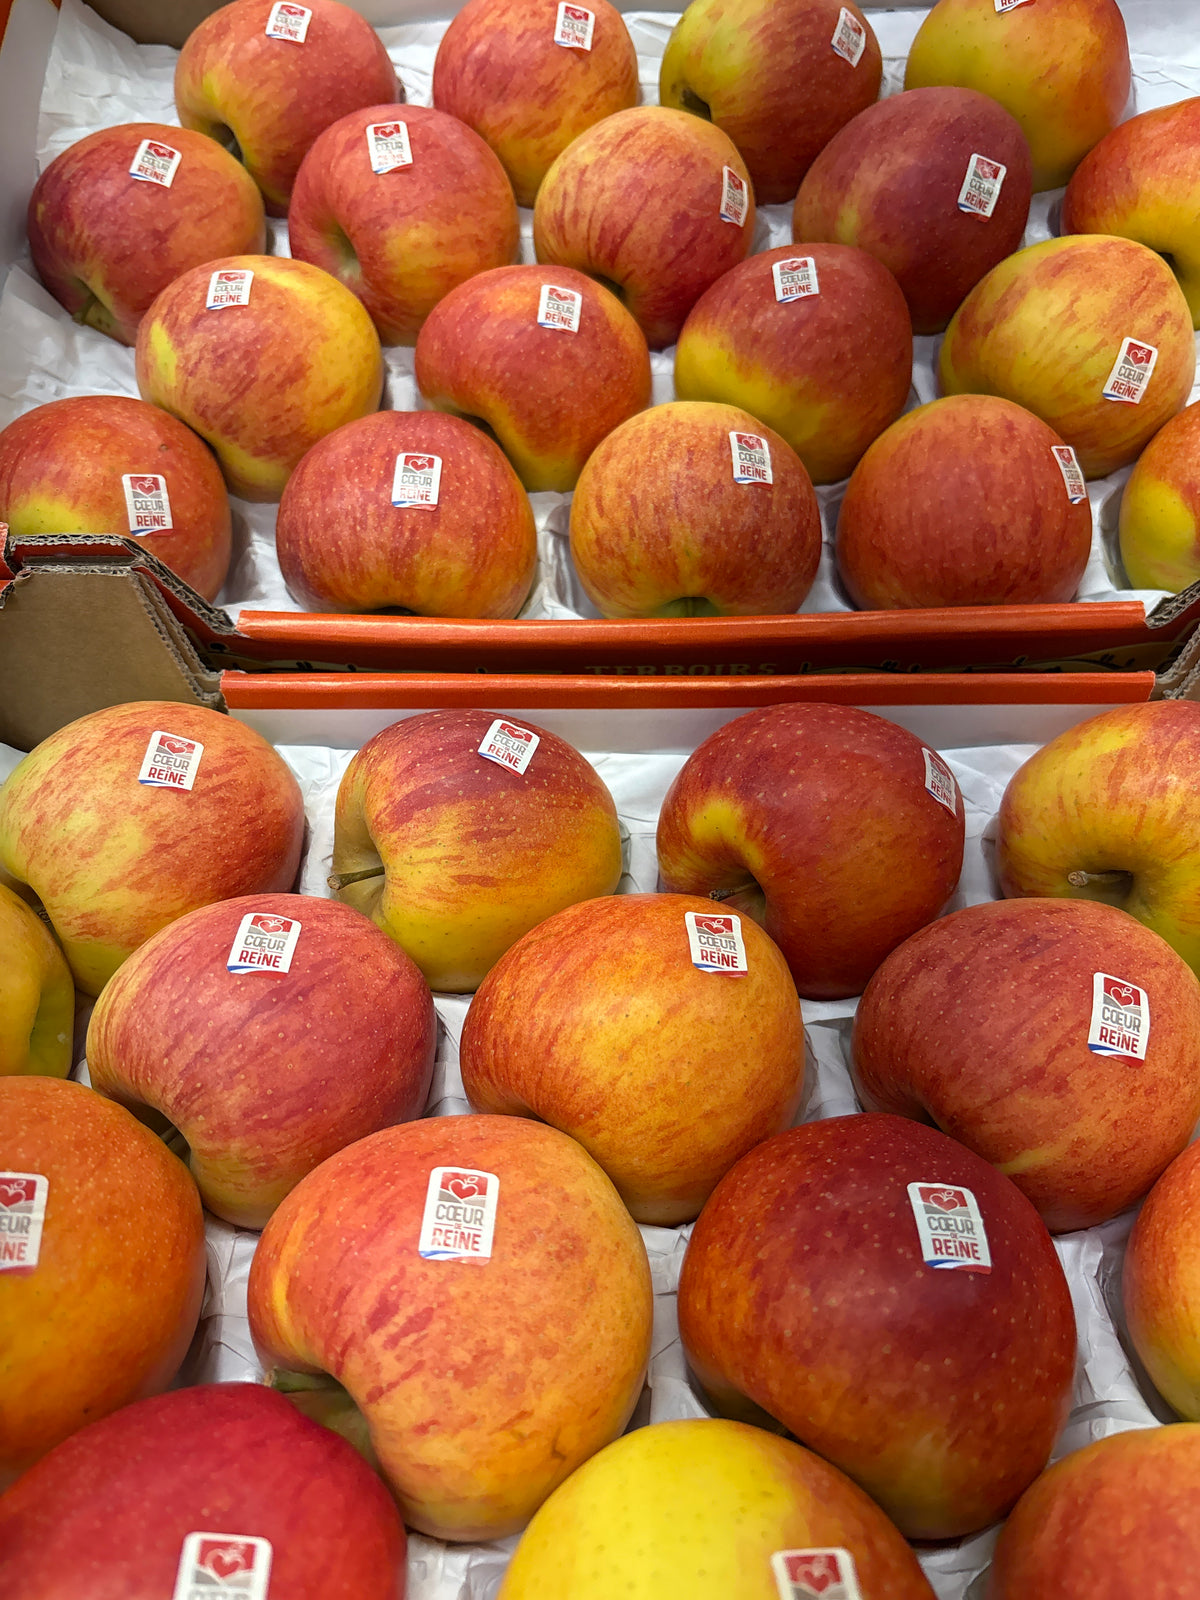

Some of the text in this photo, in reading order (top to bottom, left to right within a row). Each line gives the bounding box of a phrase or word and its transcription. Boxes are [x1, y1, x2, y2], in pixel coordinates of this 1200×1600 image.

[1117, 366, 1144, 385] CŒUR
[739, 451, 766, 467] CŒUR
[401, 474, 432, 487] CŒUR
[134, 500, 164, 511] CŒUR
[493, 733, 527, 756] CŒUR
[153, 753, 190, 771] CŒUR
[488, 743, 521, 769] REiNE
[148, 766, 186, 786] REiNE
[243, 934, 286, 952] CŒUR
[698, 935, 738, 952] CŒUR
[239, 950, 282, 968] REiNE
[701, 949, 740, 969] REiNE
[1101, 1006, 1142, 1033] CŒUR
[1099, 1028, 1139, 1055] REiNE
[435, 1203, 485, 1226] CŒUR
[926, 1216, 976, 1235] CŒUR
[931, 1238, 981, 1260] REiNE
